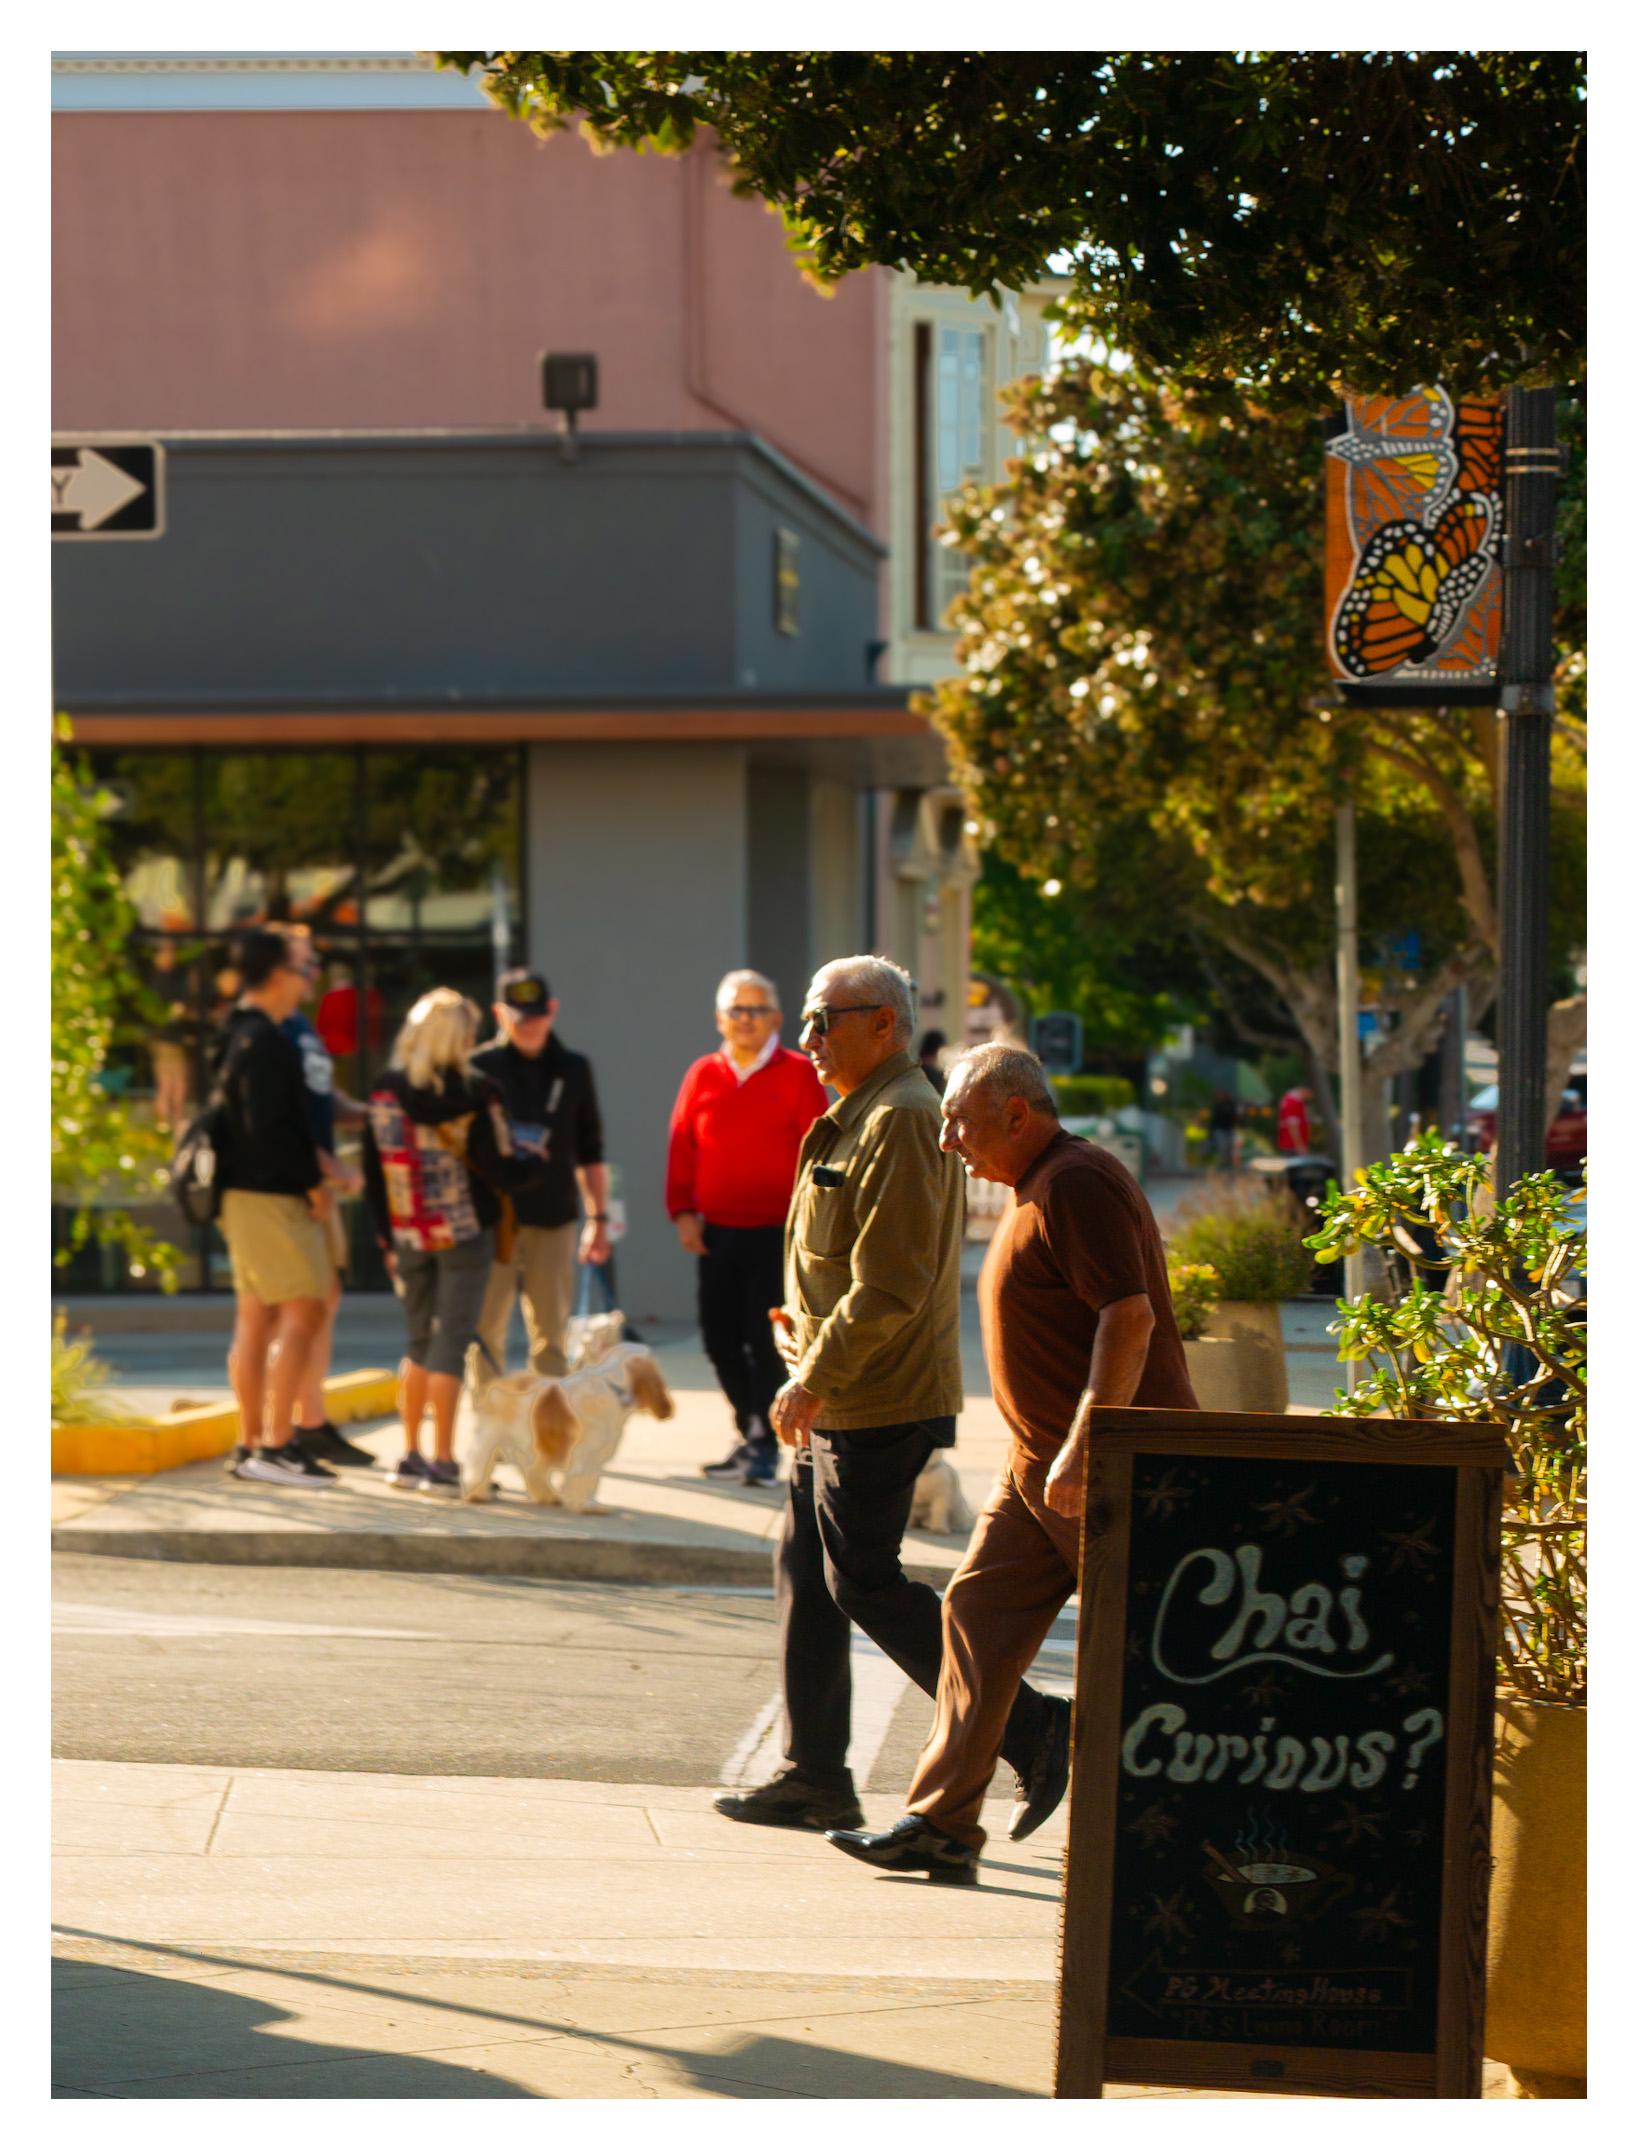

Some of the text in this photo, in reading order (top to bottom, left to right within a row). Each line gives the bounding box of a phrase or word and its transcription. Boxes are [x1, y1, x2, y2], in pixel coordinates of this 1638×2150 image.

[1152, 1544, 1394, 1686] Chai
[1122, 1703, 1444, 1792] Curious?
[1164, 1975, 1199, 1999] PG
